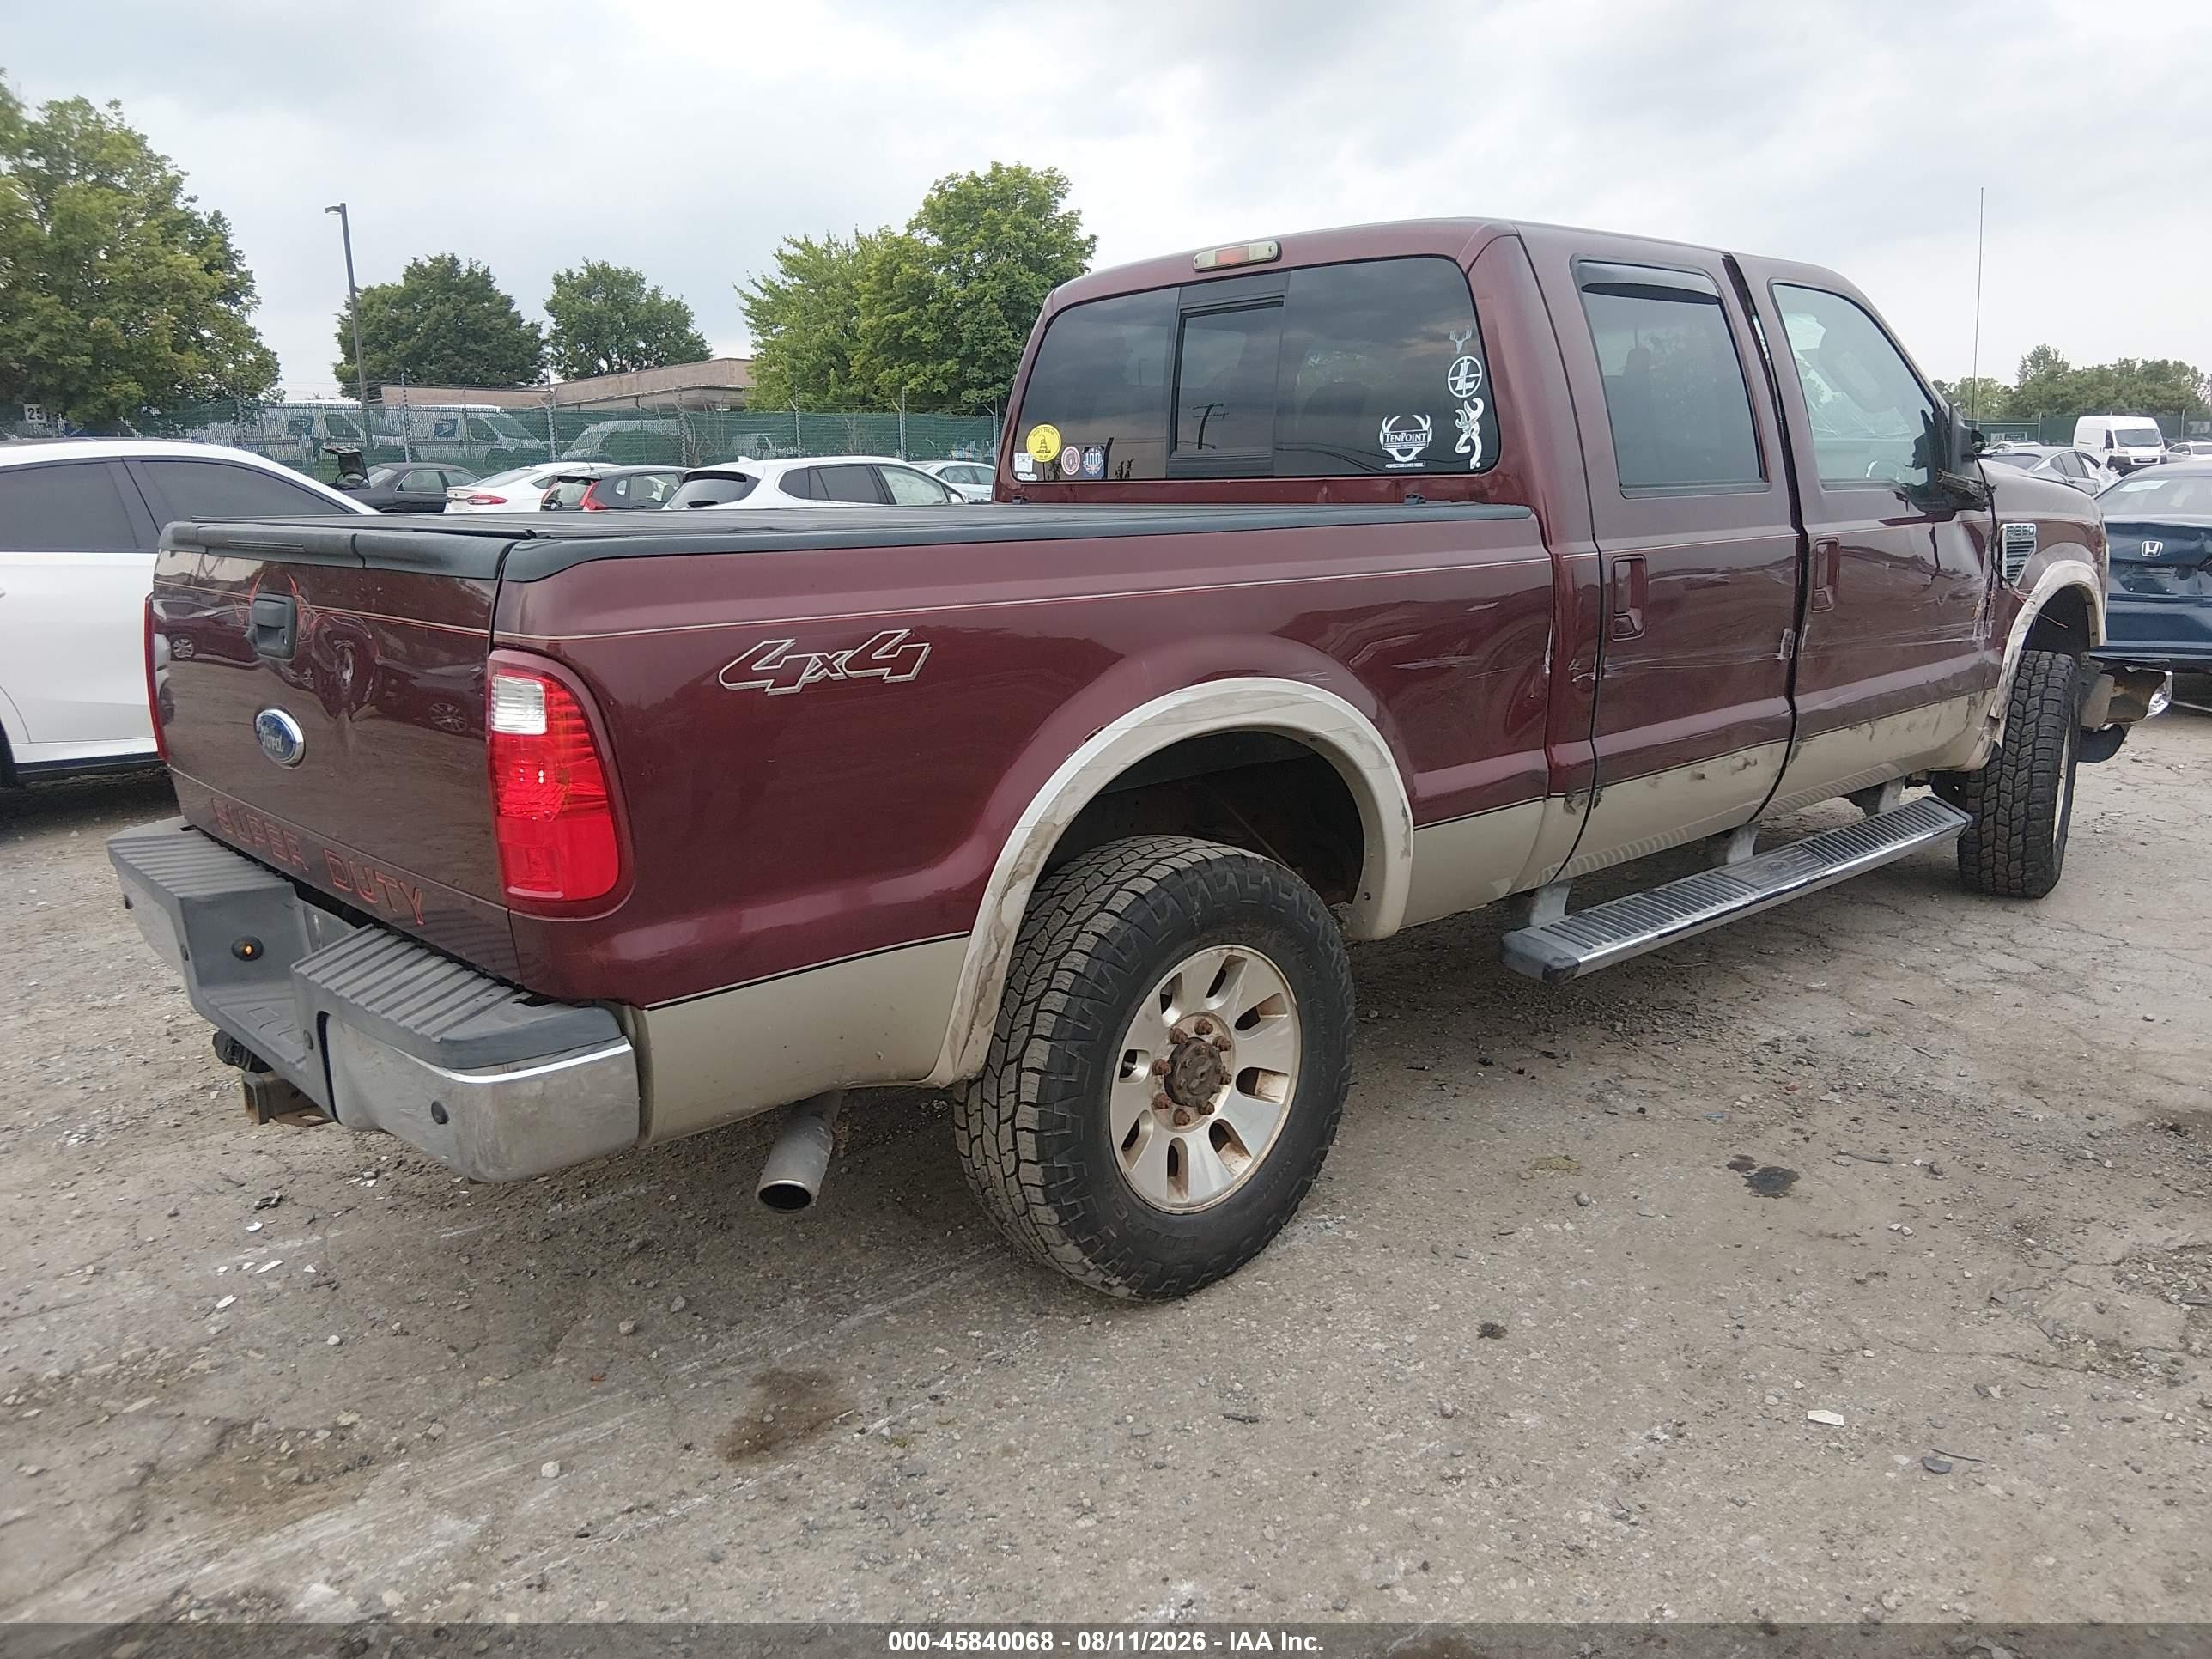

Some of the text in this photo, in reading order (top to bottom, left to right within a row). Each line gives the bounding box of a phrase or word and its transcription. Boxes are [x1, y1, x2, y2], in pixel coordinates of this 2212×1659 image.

[27, 407, 45, 421] 25
[719, 629, 932, 696] 4x4
[259, 720, 284, 753] Ford
[211, 798, 424, 927] SUPER DUTY
